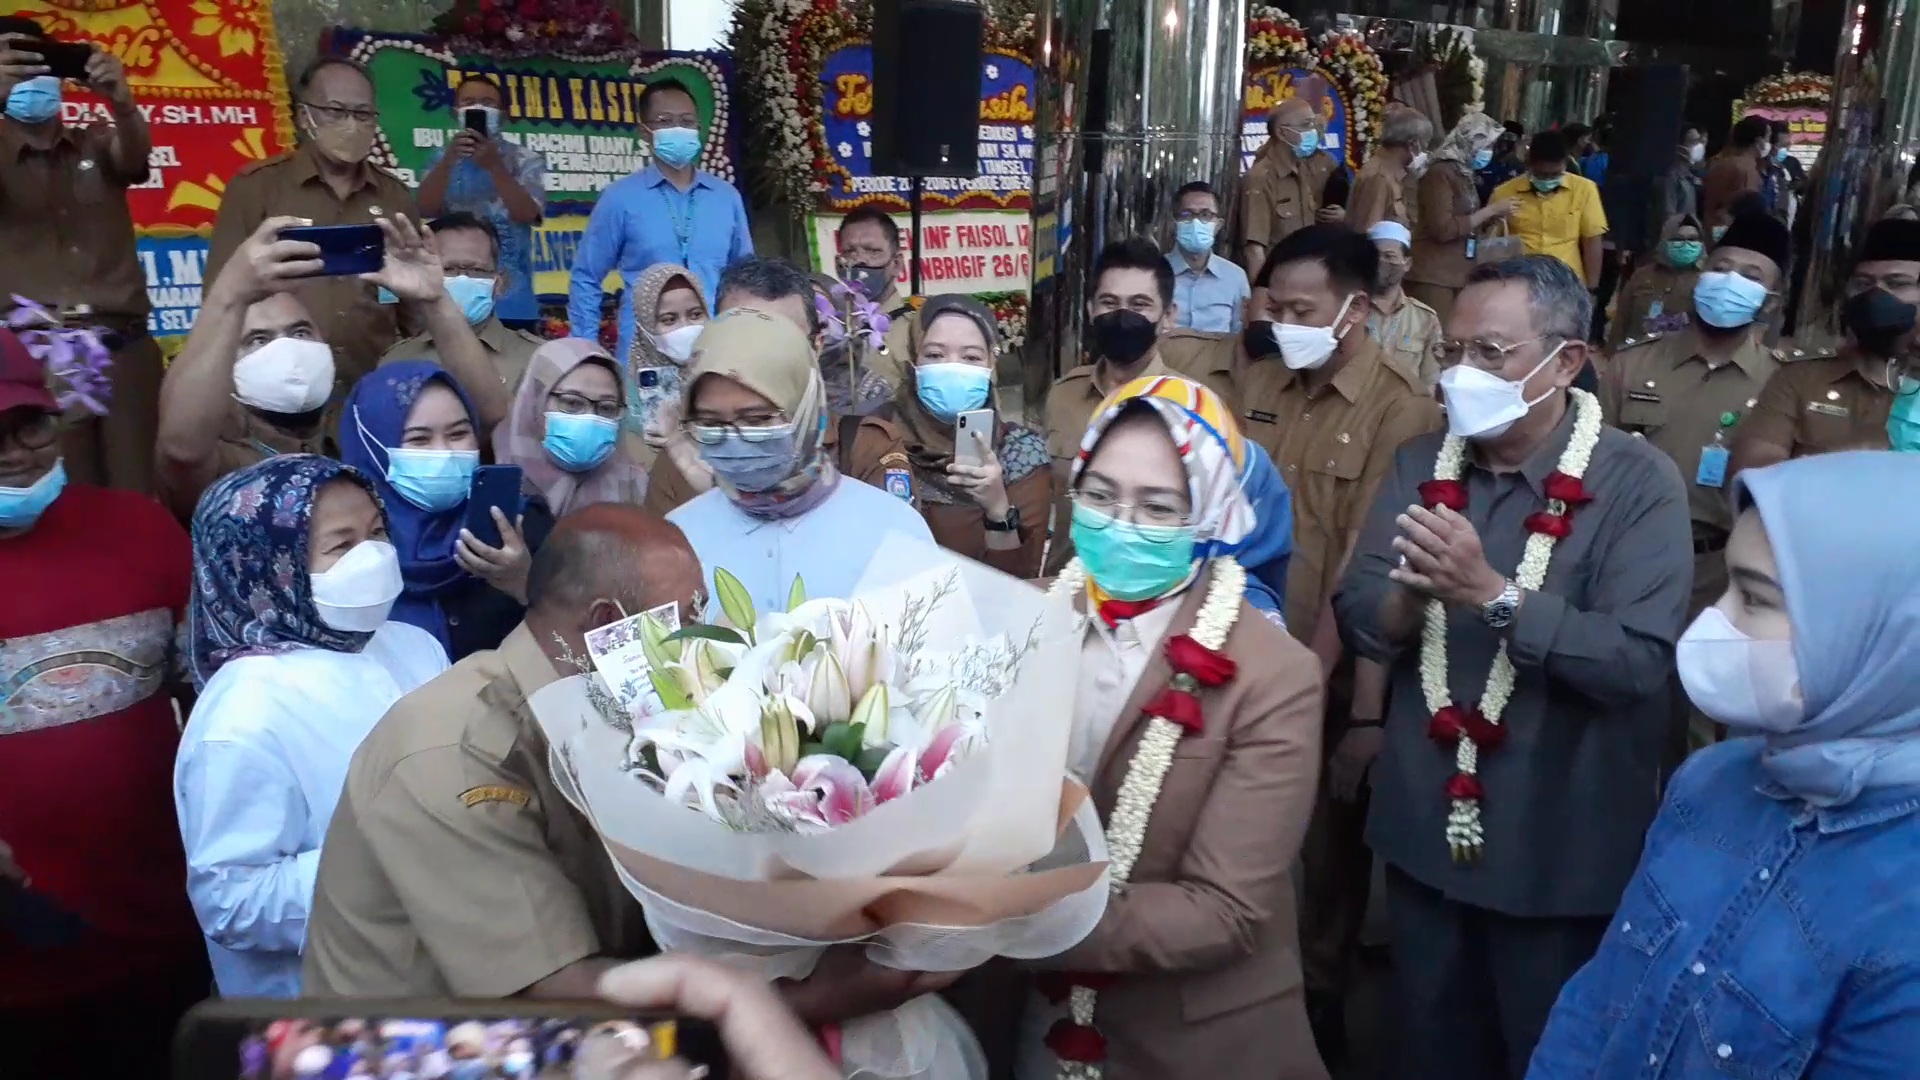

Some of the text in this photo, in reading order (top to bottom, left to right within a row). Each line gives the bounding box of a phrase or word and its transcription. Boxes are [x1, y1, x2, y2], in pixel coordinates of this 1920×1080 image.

[61, 102, 257, 124] DIAY,SH.MH
[922, 226, 952, 250] INF
[956, 224, 1014, 248] FAISOL
